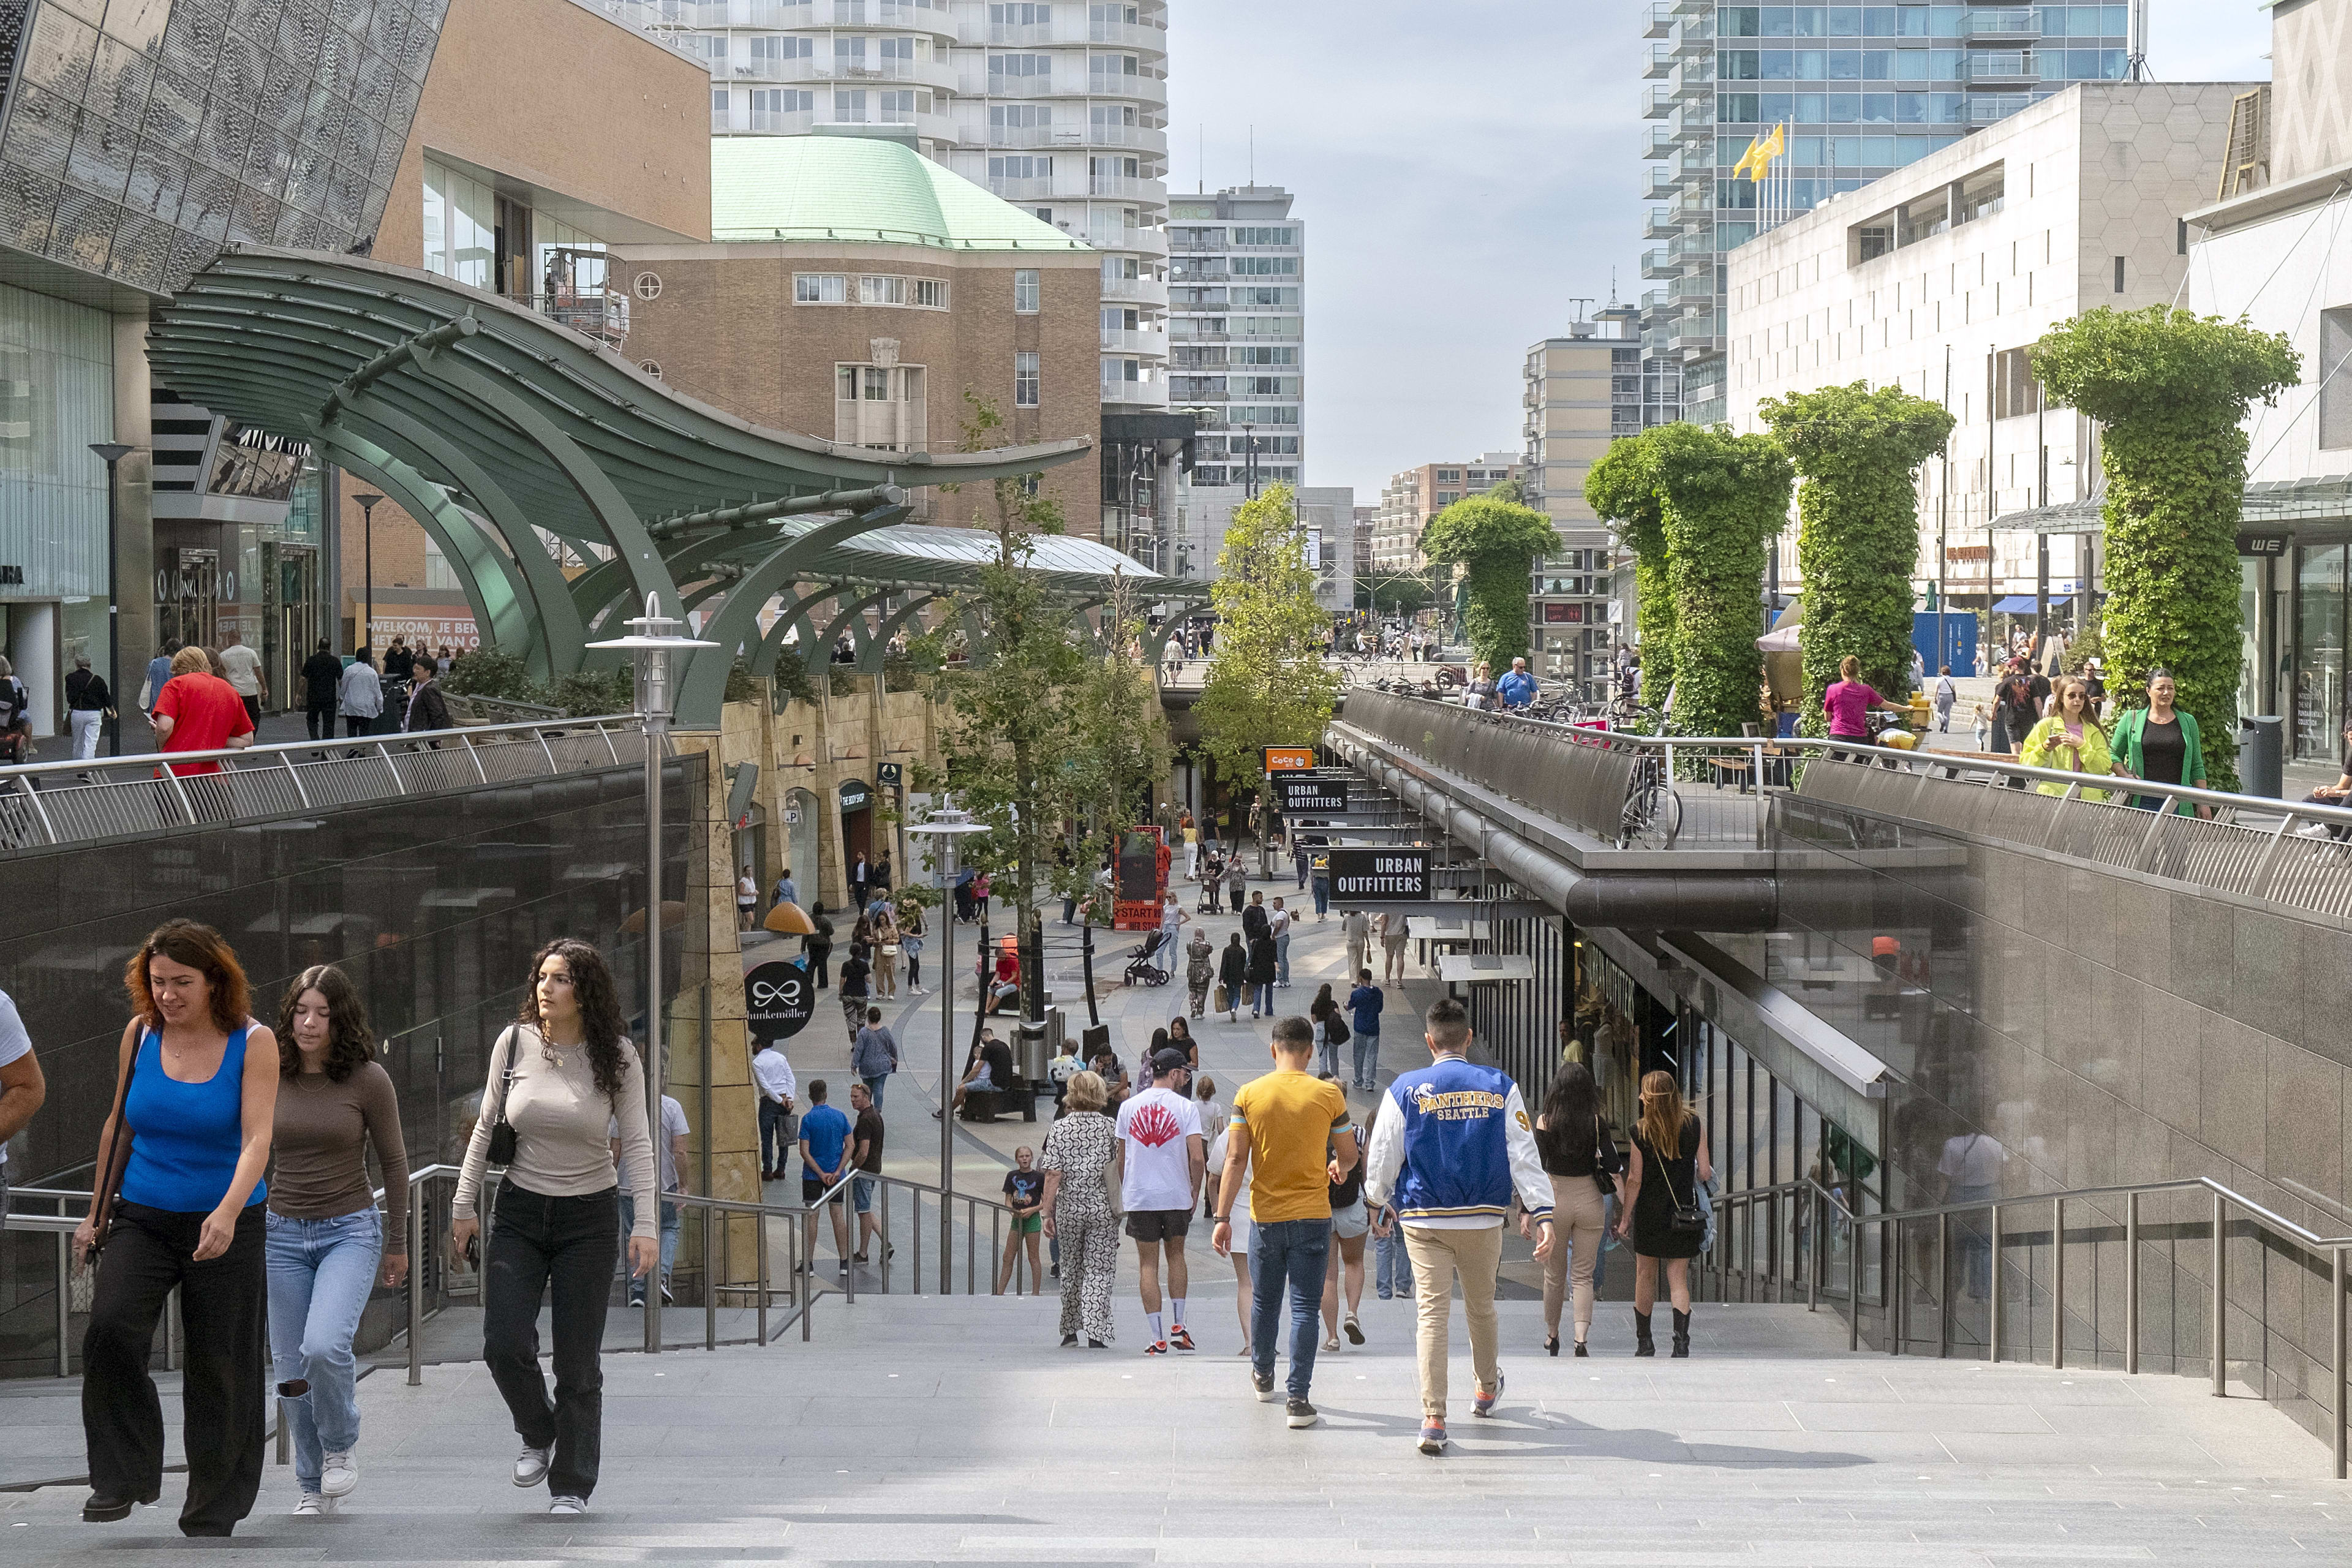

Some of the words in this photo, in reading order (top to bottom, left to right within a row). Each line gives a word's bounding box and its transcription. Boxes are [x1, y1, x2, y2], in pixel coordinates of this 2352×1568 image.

[2251, 540, 2280, 551] WE
[0, 565, 25, 584] RA
[437, 623, 451, 633] JE
[437, 636, 465, 647] VAN
[1288, 785, 1318, 796] URBAN
[856, 793, 865, 803] SHOP
[1288, 797, 1342, 807] OUTFITTERS
[790, 812, 796, 822] P
[1376, 858, 1422, 873] URBAN
[1338, 876, 1422, 892] OUTFITTERS
[1121, 908, 1152, 918] START
[747, 1008, 807, 1020] hunkemöller
[1418, 1091, 1505, 1115] PANTHERS
[1436, 1107, 1490, 1120] SEATTLE
